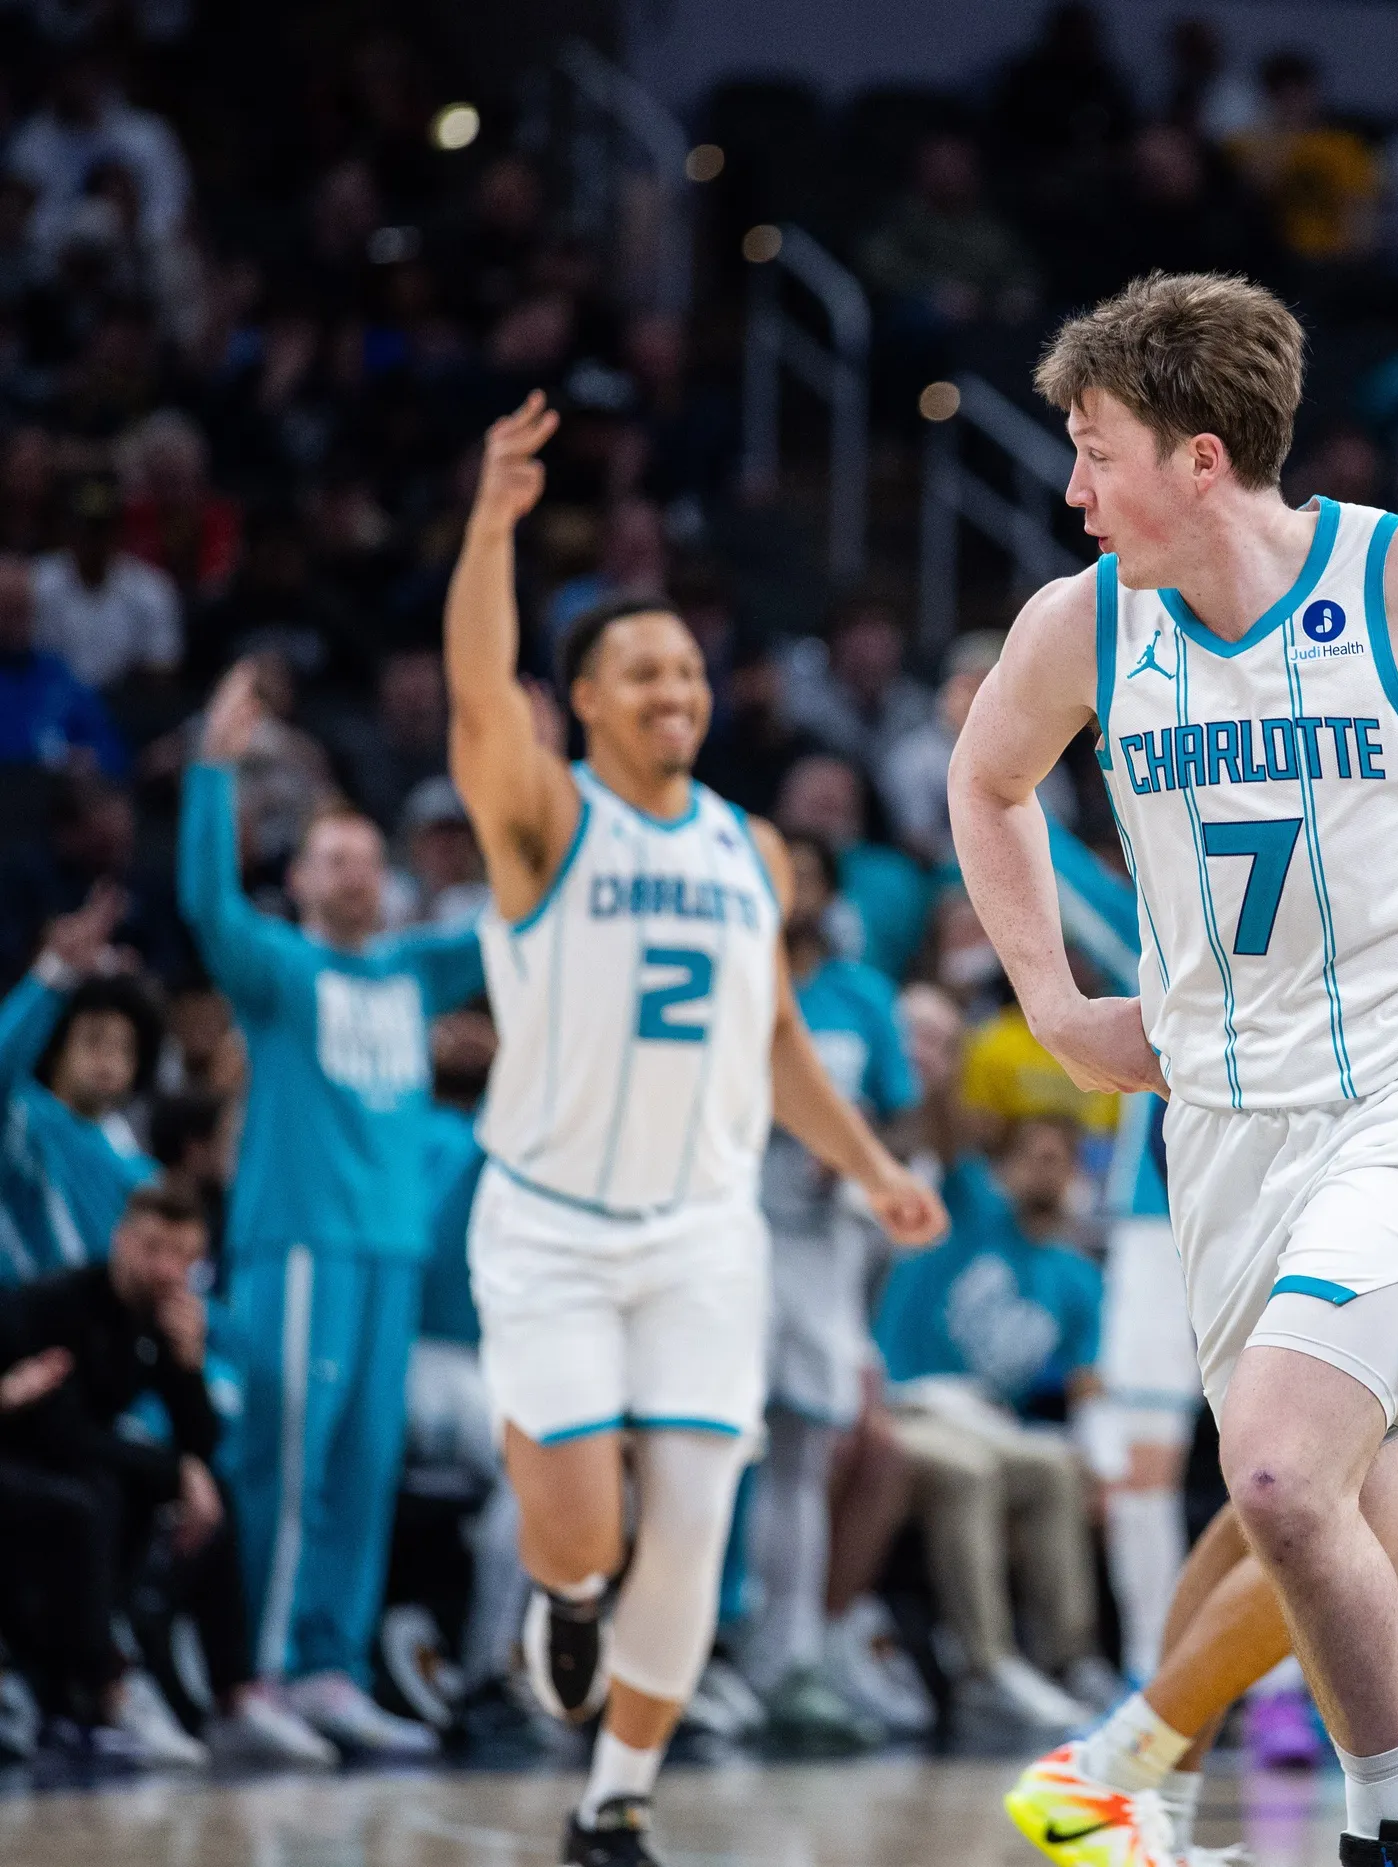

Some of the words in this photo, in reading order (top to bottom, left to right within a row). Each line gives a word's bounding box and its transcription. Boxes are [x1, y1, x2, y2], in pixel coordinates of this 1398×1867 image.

[1290, 646, 1321, 661] Judi
[1323, 641, 1364, 657] Health
[1119, 717, 1386, 795] CHARLOTTE
[1202, 817, 1303, 956] 7
[637, 947, 713, 1041] 2
